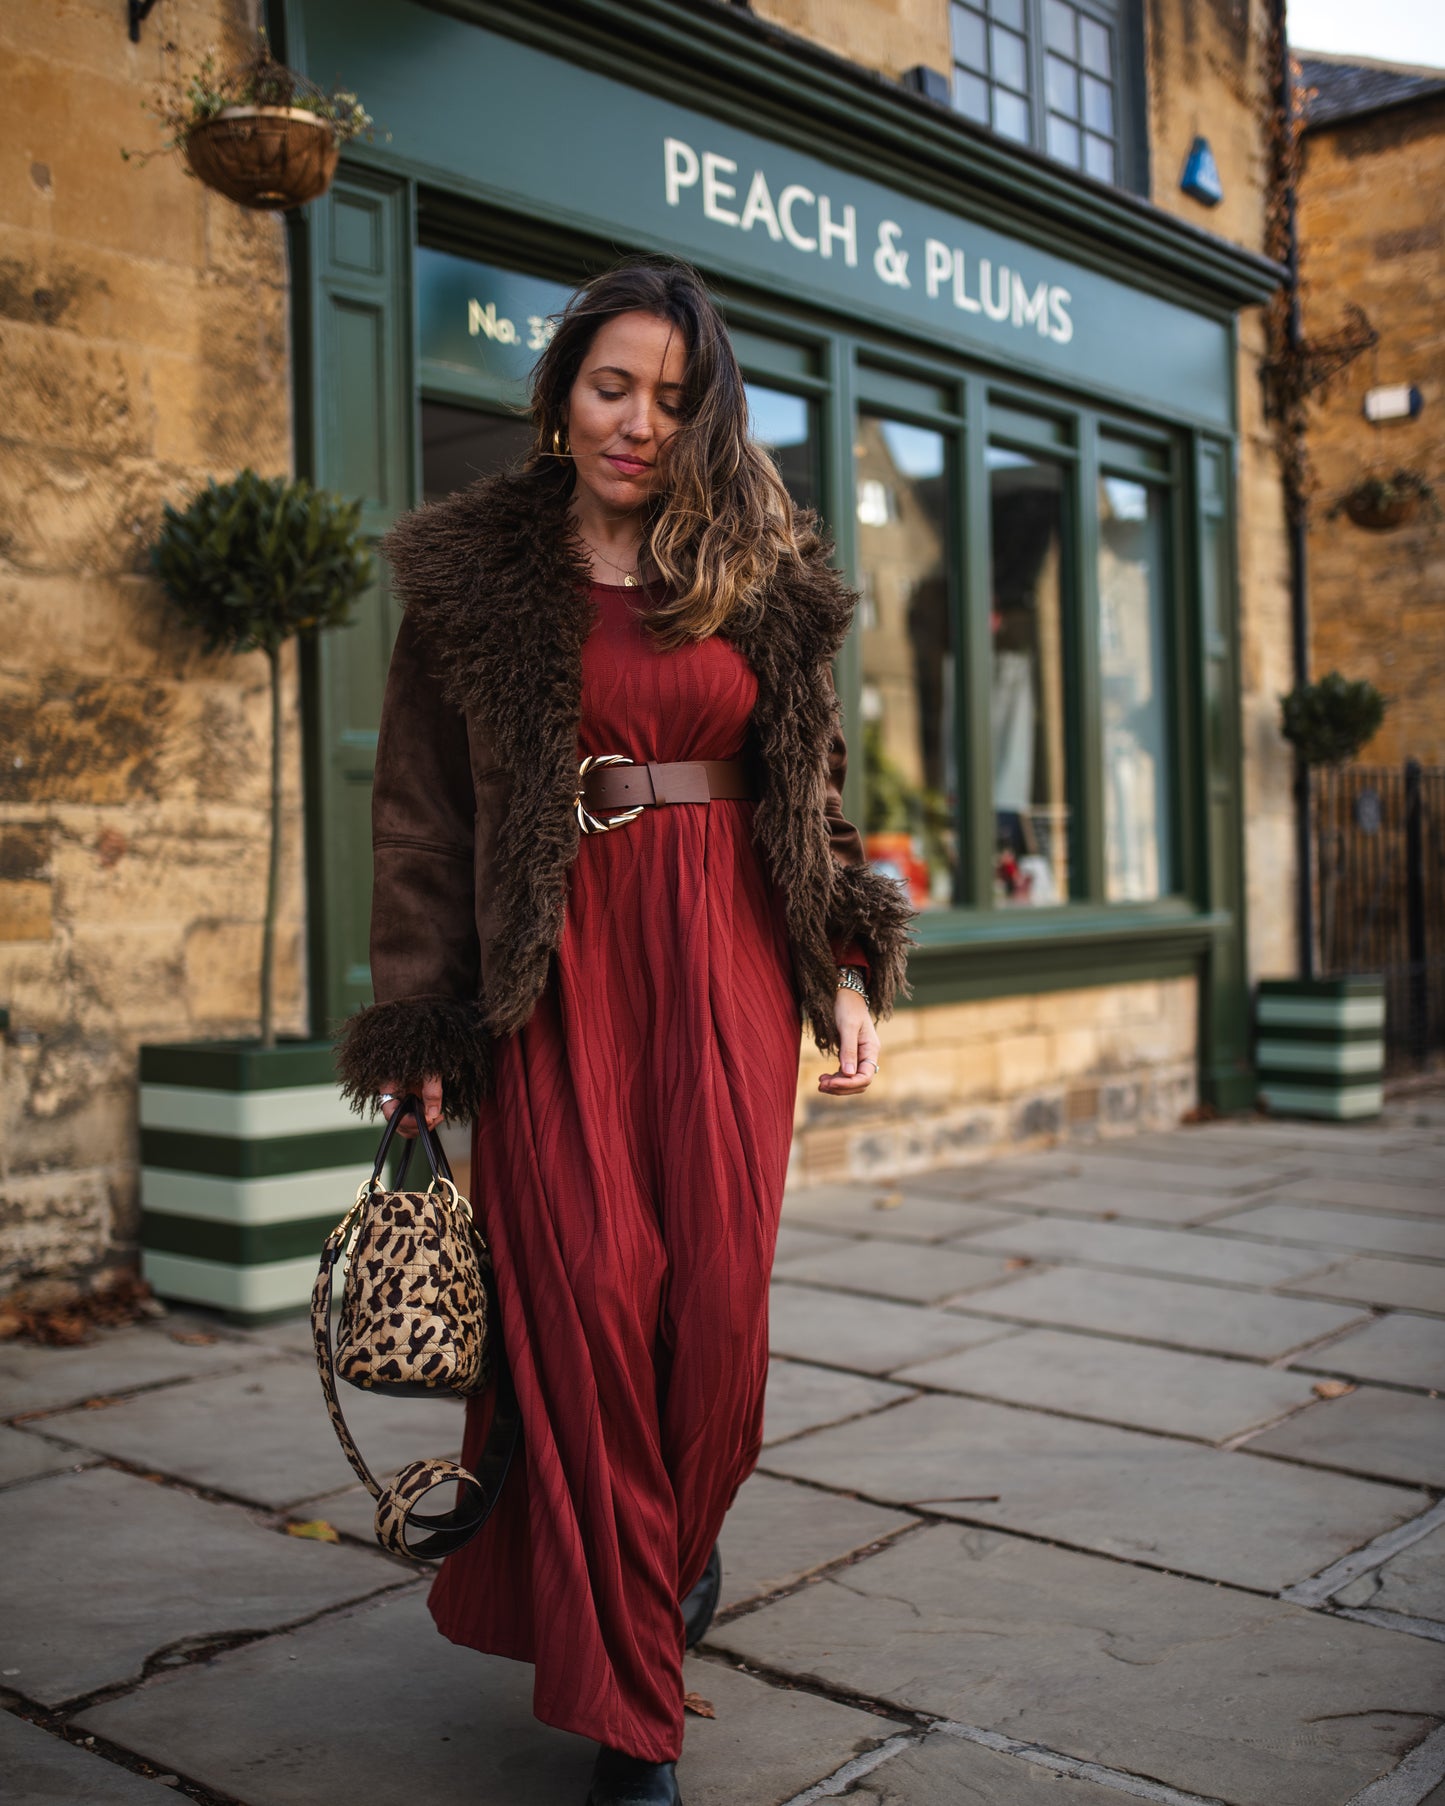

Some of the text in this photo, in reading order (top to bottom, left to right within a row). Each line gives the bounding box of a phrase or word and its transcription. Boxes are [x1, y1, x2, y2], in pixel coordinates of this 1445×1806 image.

[663, 137, 1074, 344] PEACH & PLUMS
[468, 298, 521, 346] No.
